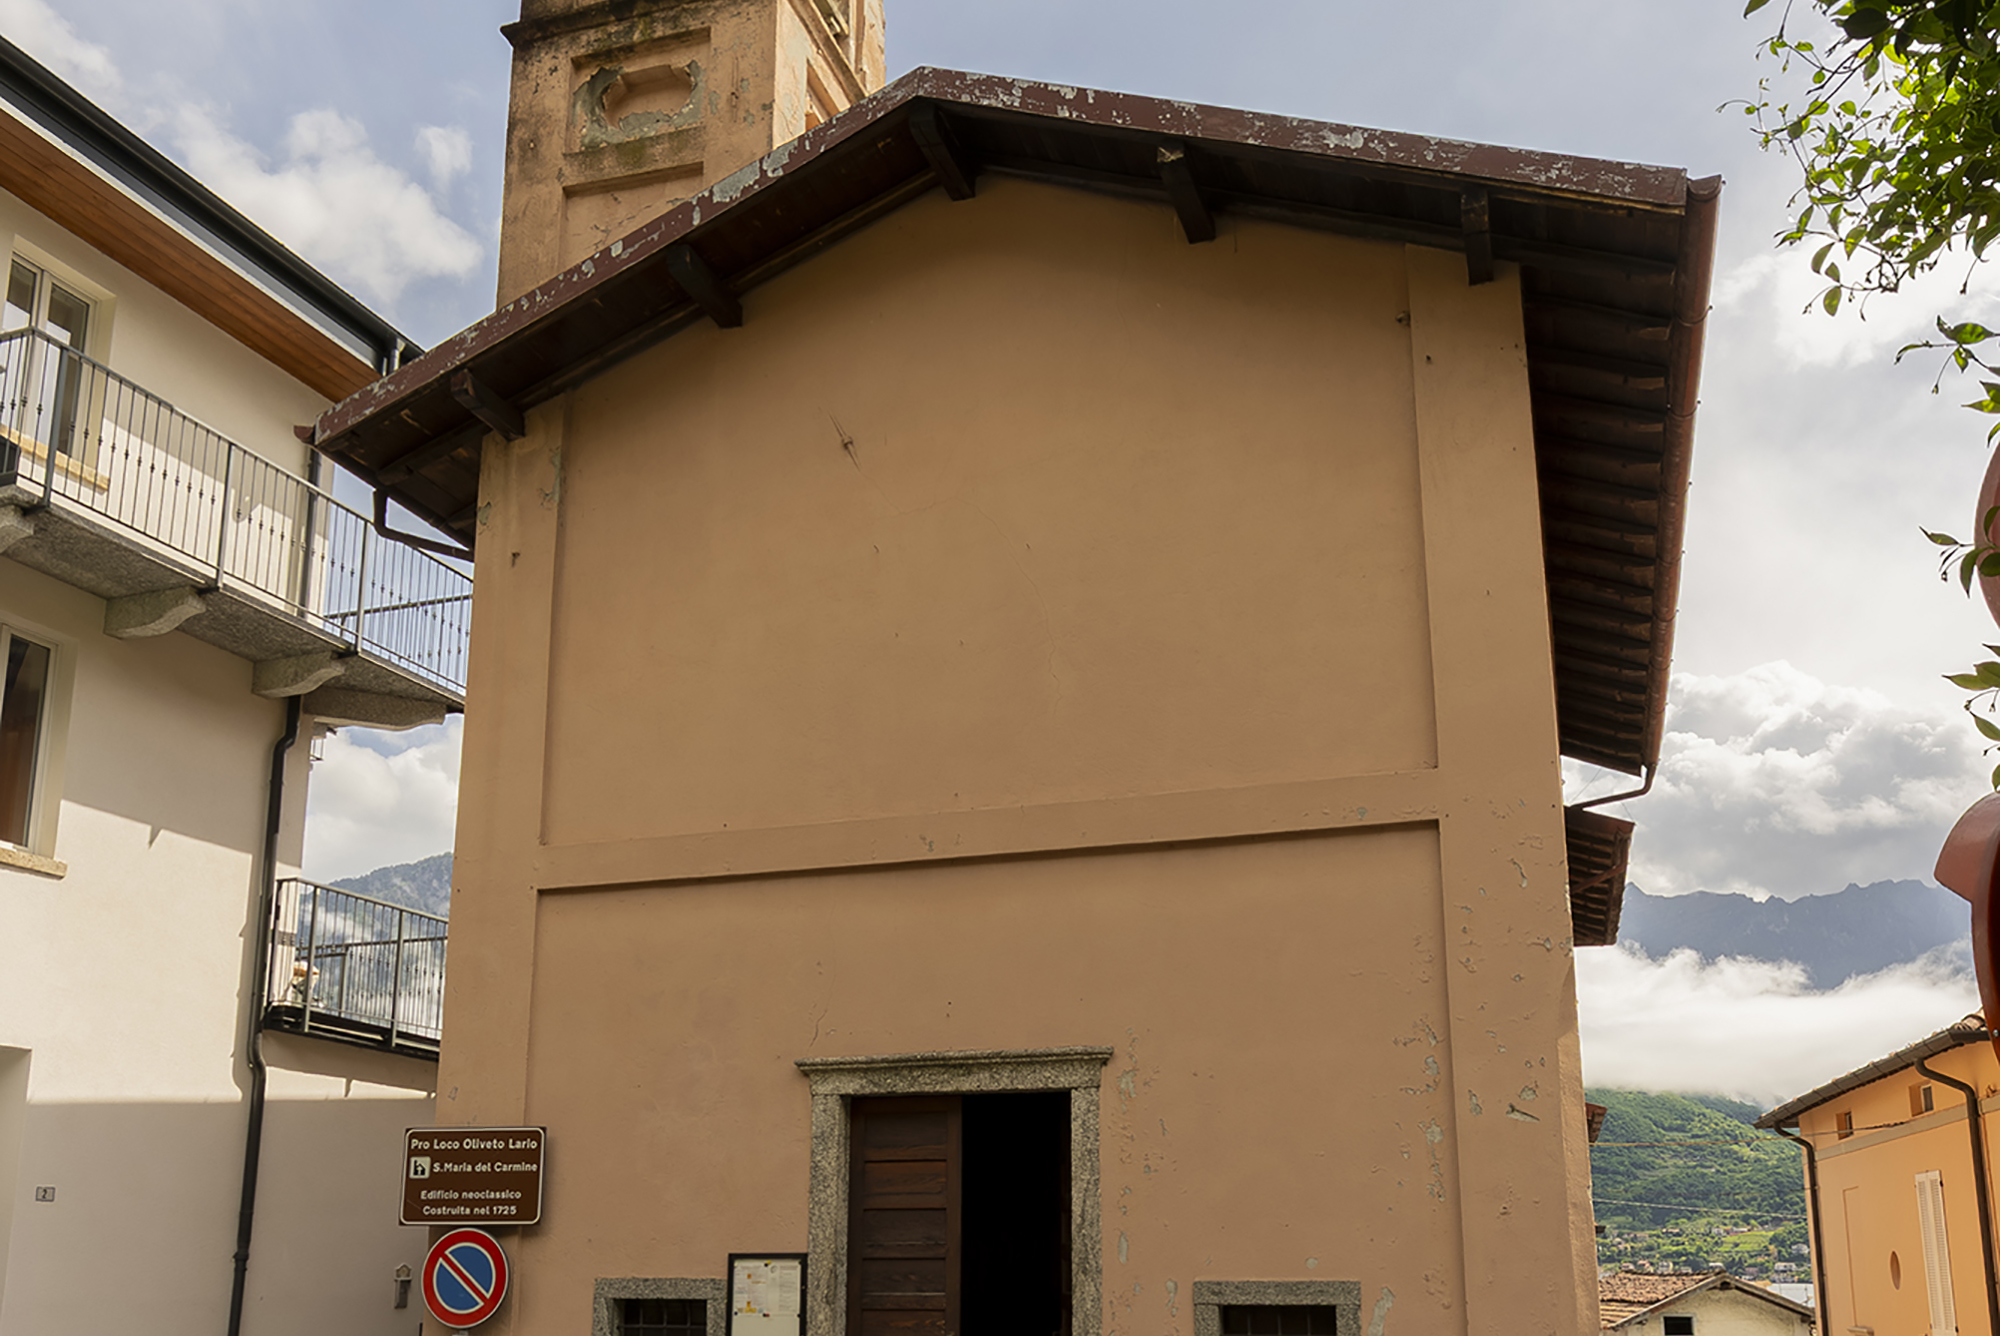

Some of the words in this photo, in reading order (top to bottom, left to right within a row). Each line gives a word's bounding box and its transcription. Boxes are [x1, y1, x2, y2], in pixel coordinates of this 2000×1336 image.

[410, 1138, 430, 1150] Pro
[433, 1138, 460, 1149] Loco
[463, 1138, 505, 1149] Oliveto
[508, 1138, 538, 1149] Lario
[475, 1161, 491, 1172] del
[494, 1161, 538, 1172] Carmine
[420, 1190, 459, 1200] Edificio
[461, 1189, 522, 1199] neoclassico
[422, 1206, 470, 1216] Costruita
[473, 1205, 490, 1215] nel
[492, 1205, 517, 1215] 1725
